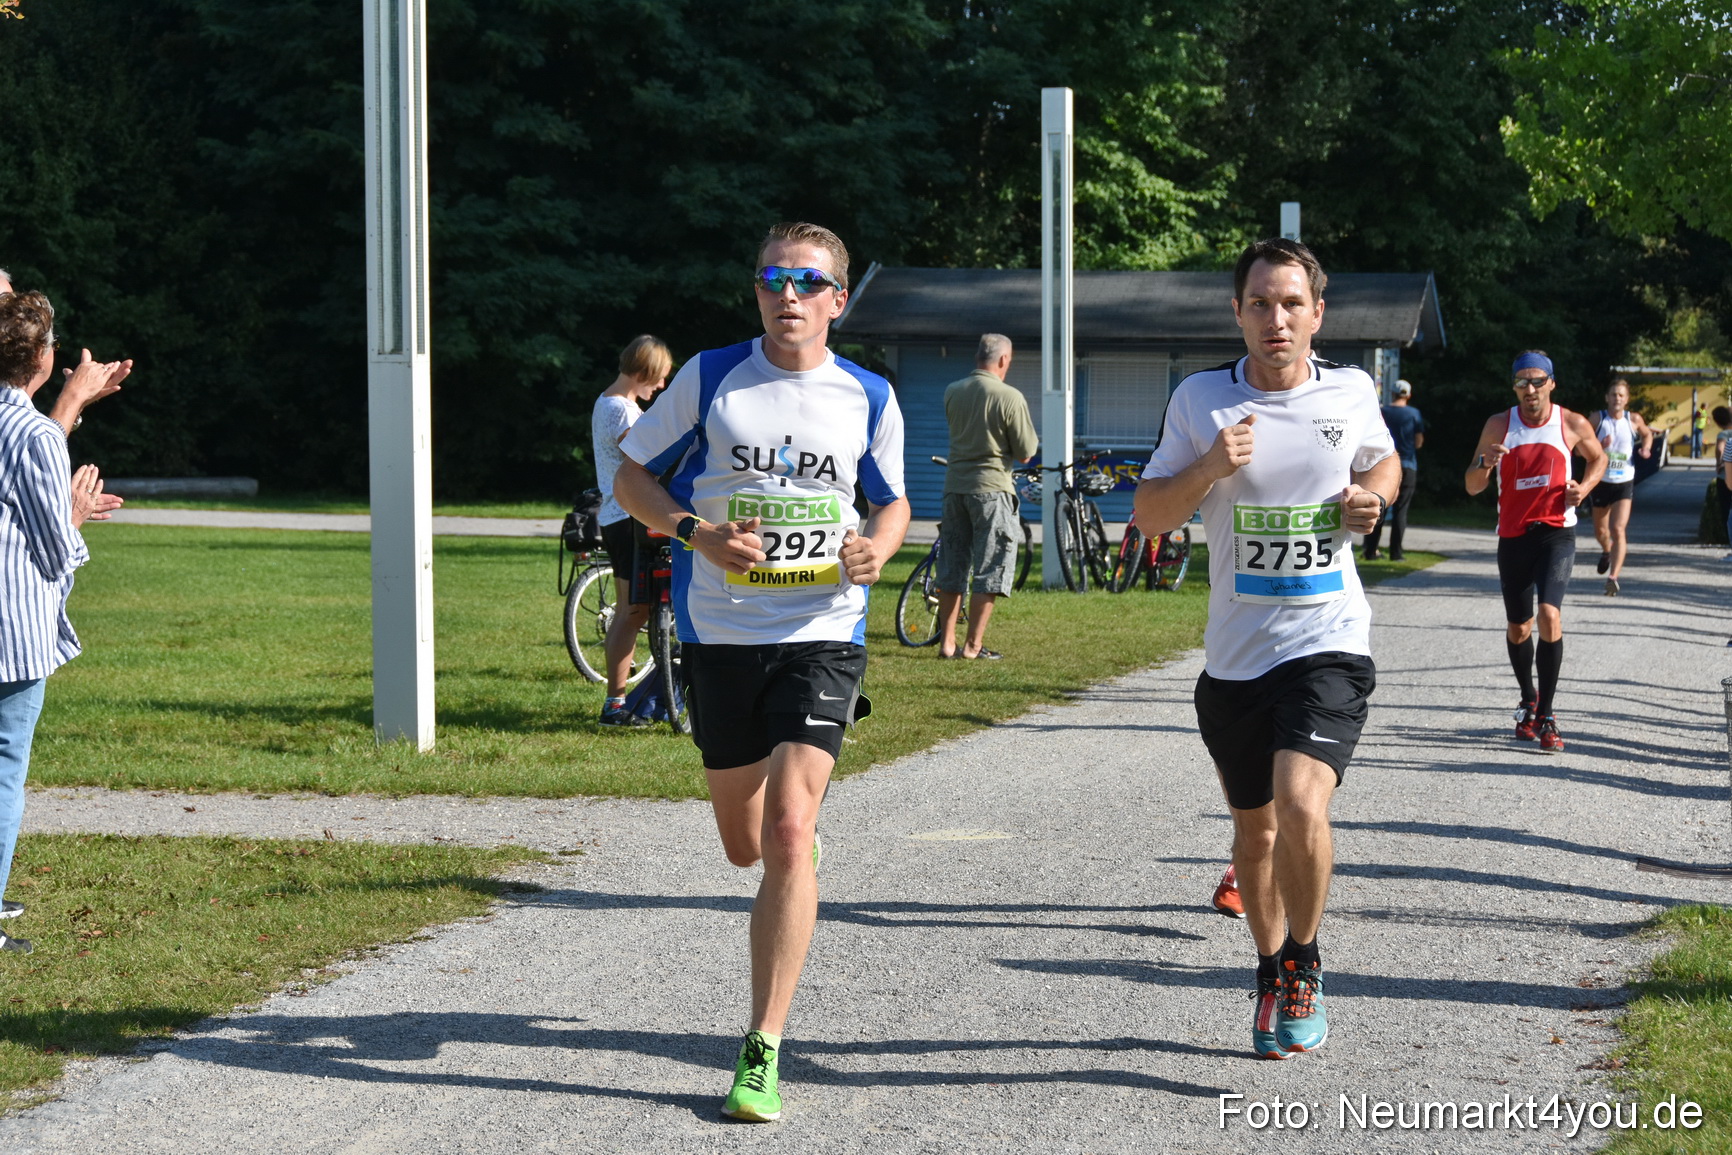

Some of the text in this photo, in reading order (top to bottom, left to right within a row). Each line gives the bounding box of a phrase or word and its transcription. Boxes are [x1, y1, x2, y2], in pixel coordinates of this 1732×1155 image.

[731, 435, 838, 487] SUSPA
[736, 499, 830, 522] BOCK
[1242, 506, 1336, 530] BOCK
[750, 529, 827, 562] 292
[1246, 537, 1333, 571] 2735
[749, 569, 816, 585] DIMITRI
